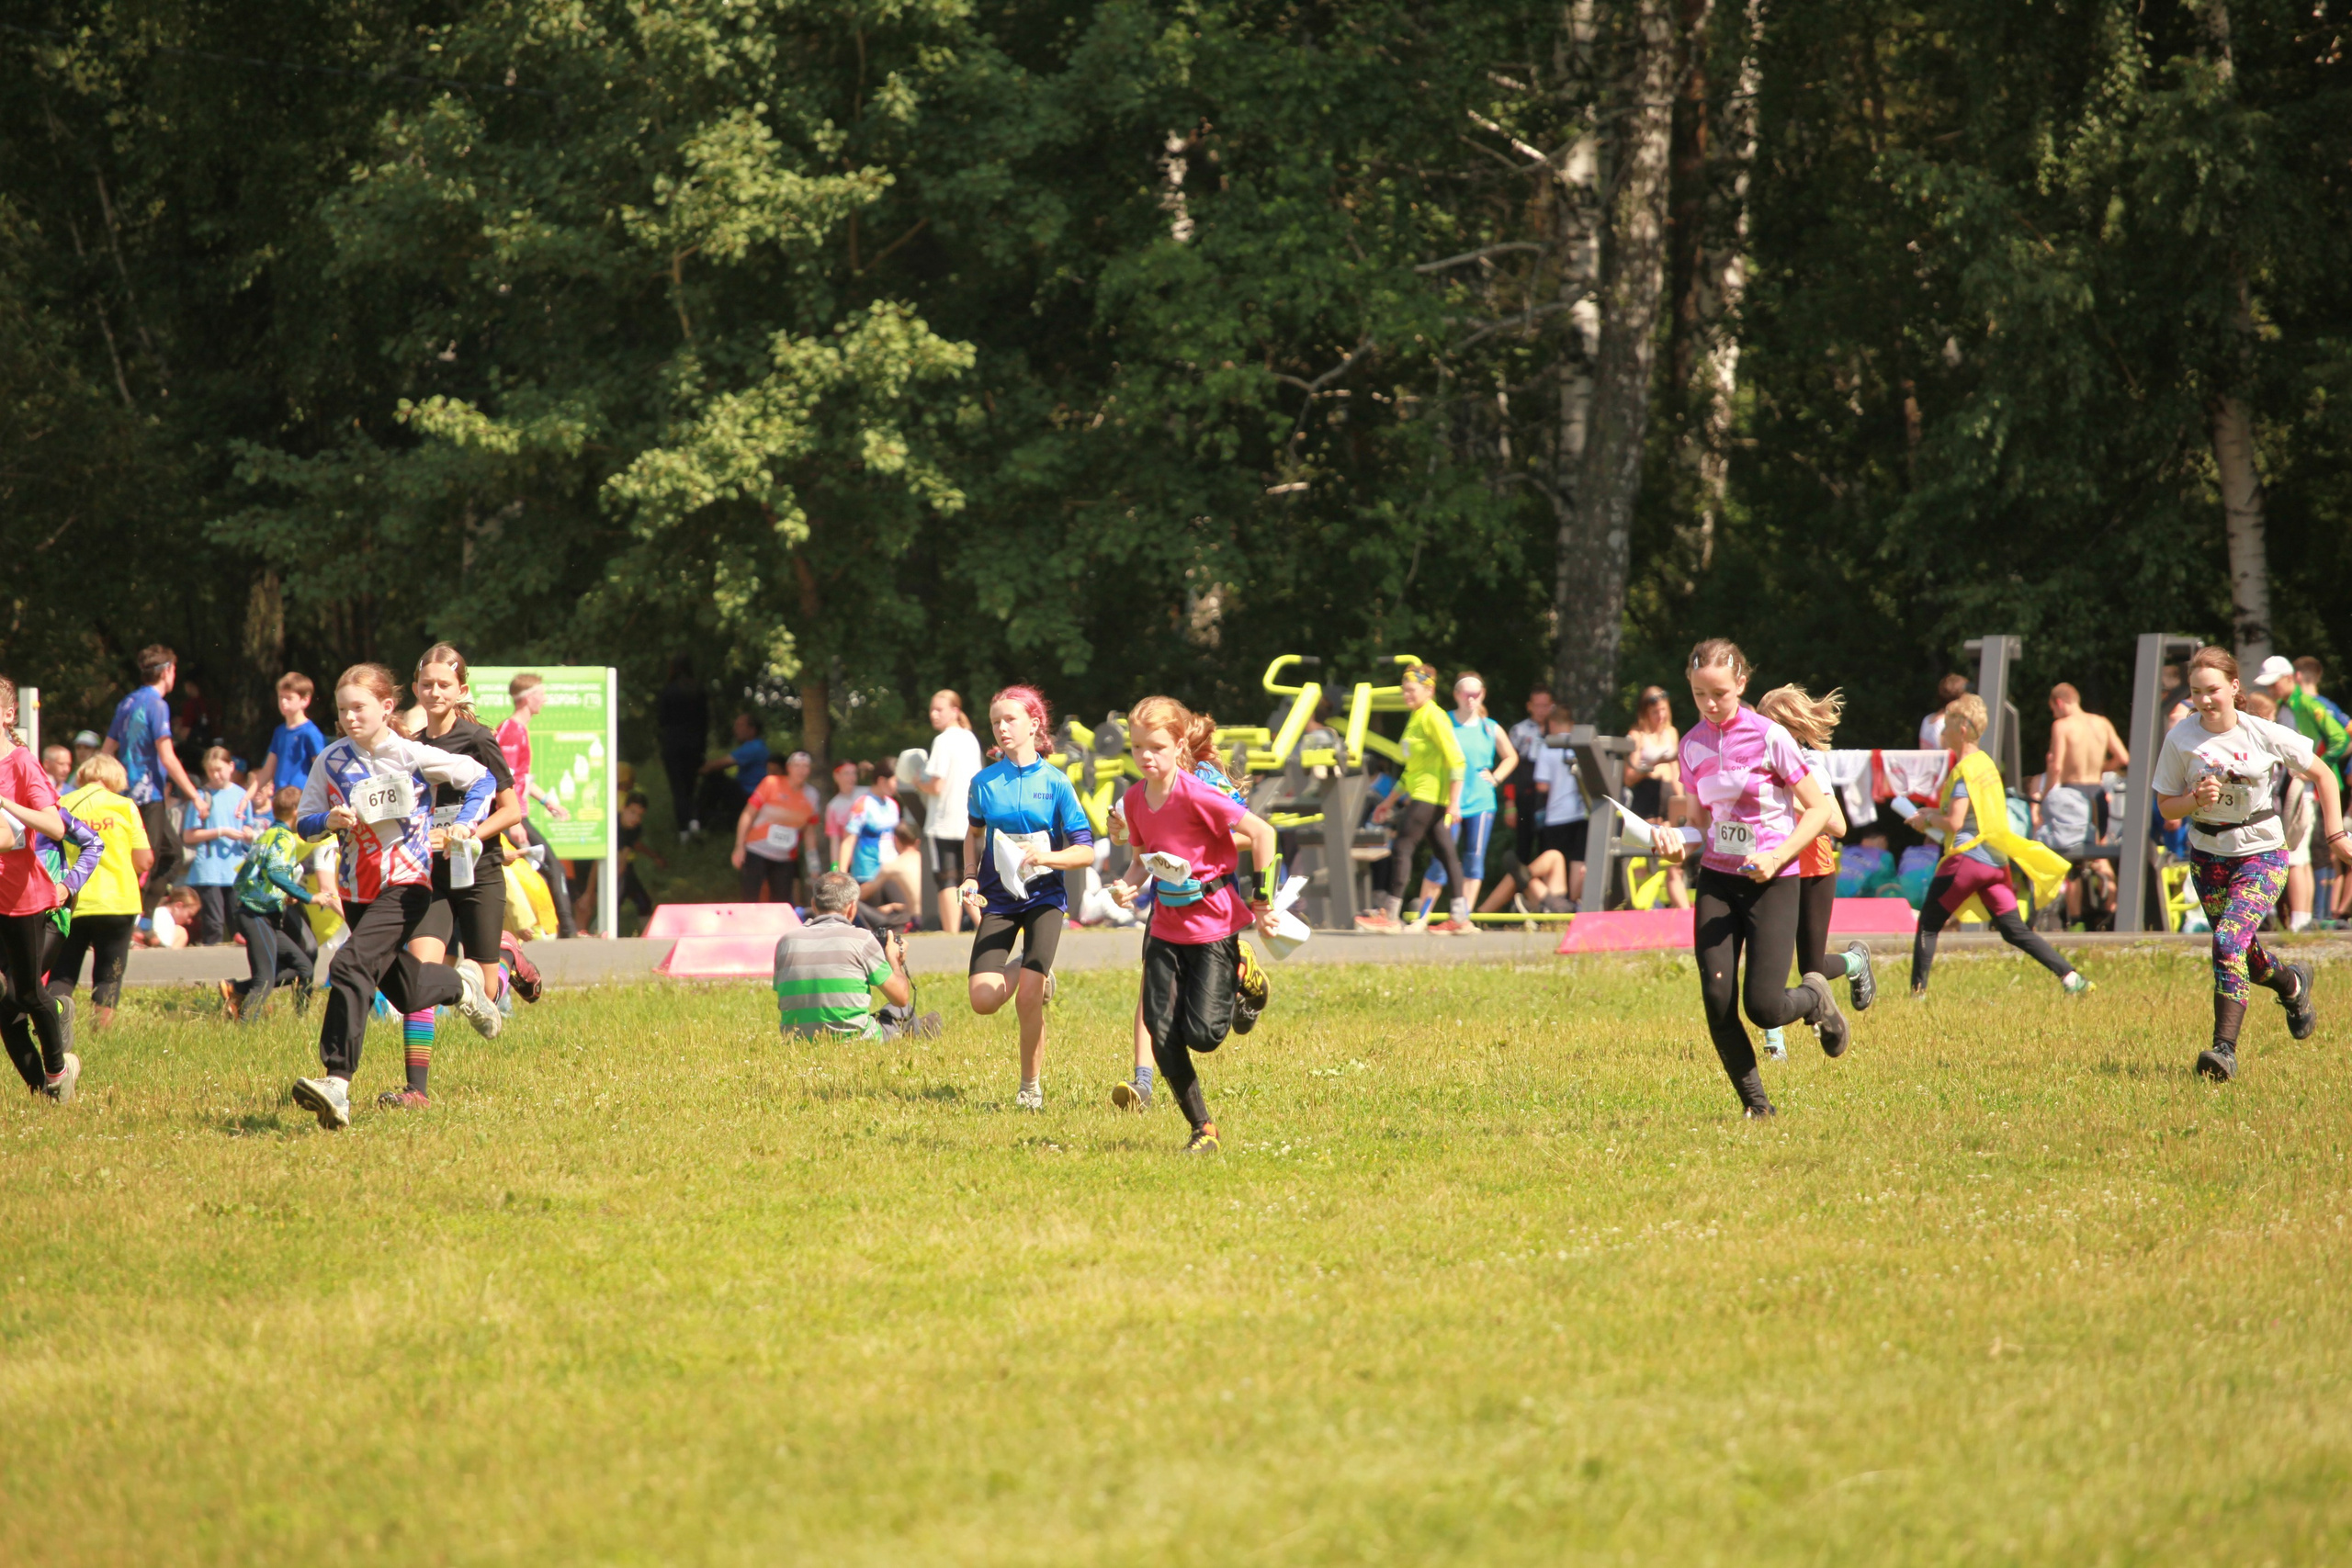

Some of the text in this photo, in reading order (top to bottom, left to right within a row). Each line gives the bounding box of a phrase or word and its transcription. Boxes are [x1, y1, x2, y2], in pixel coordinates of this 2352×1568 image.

[369, 789, 397, 807] 678
[2217, 793, 2233, 807] 73
[1721, 825, 1747, 842] 670
